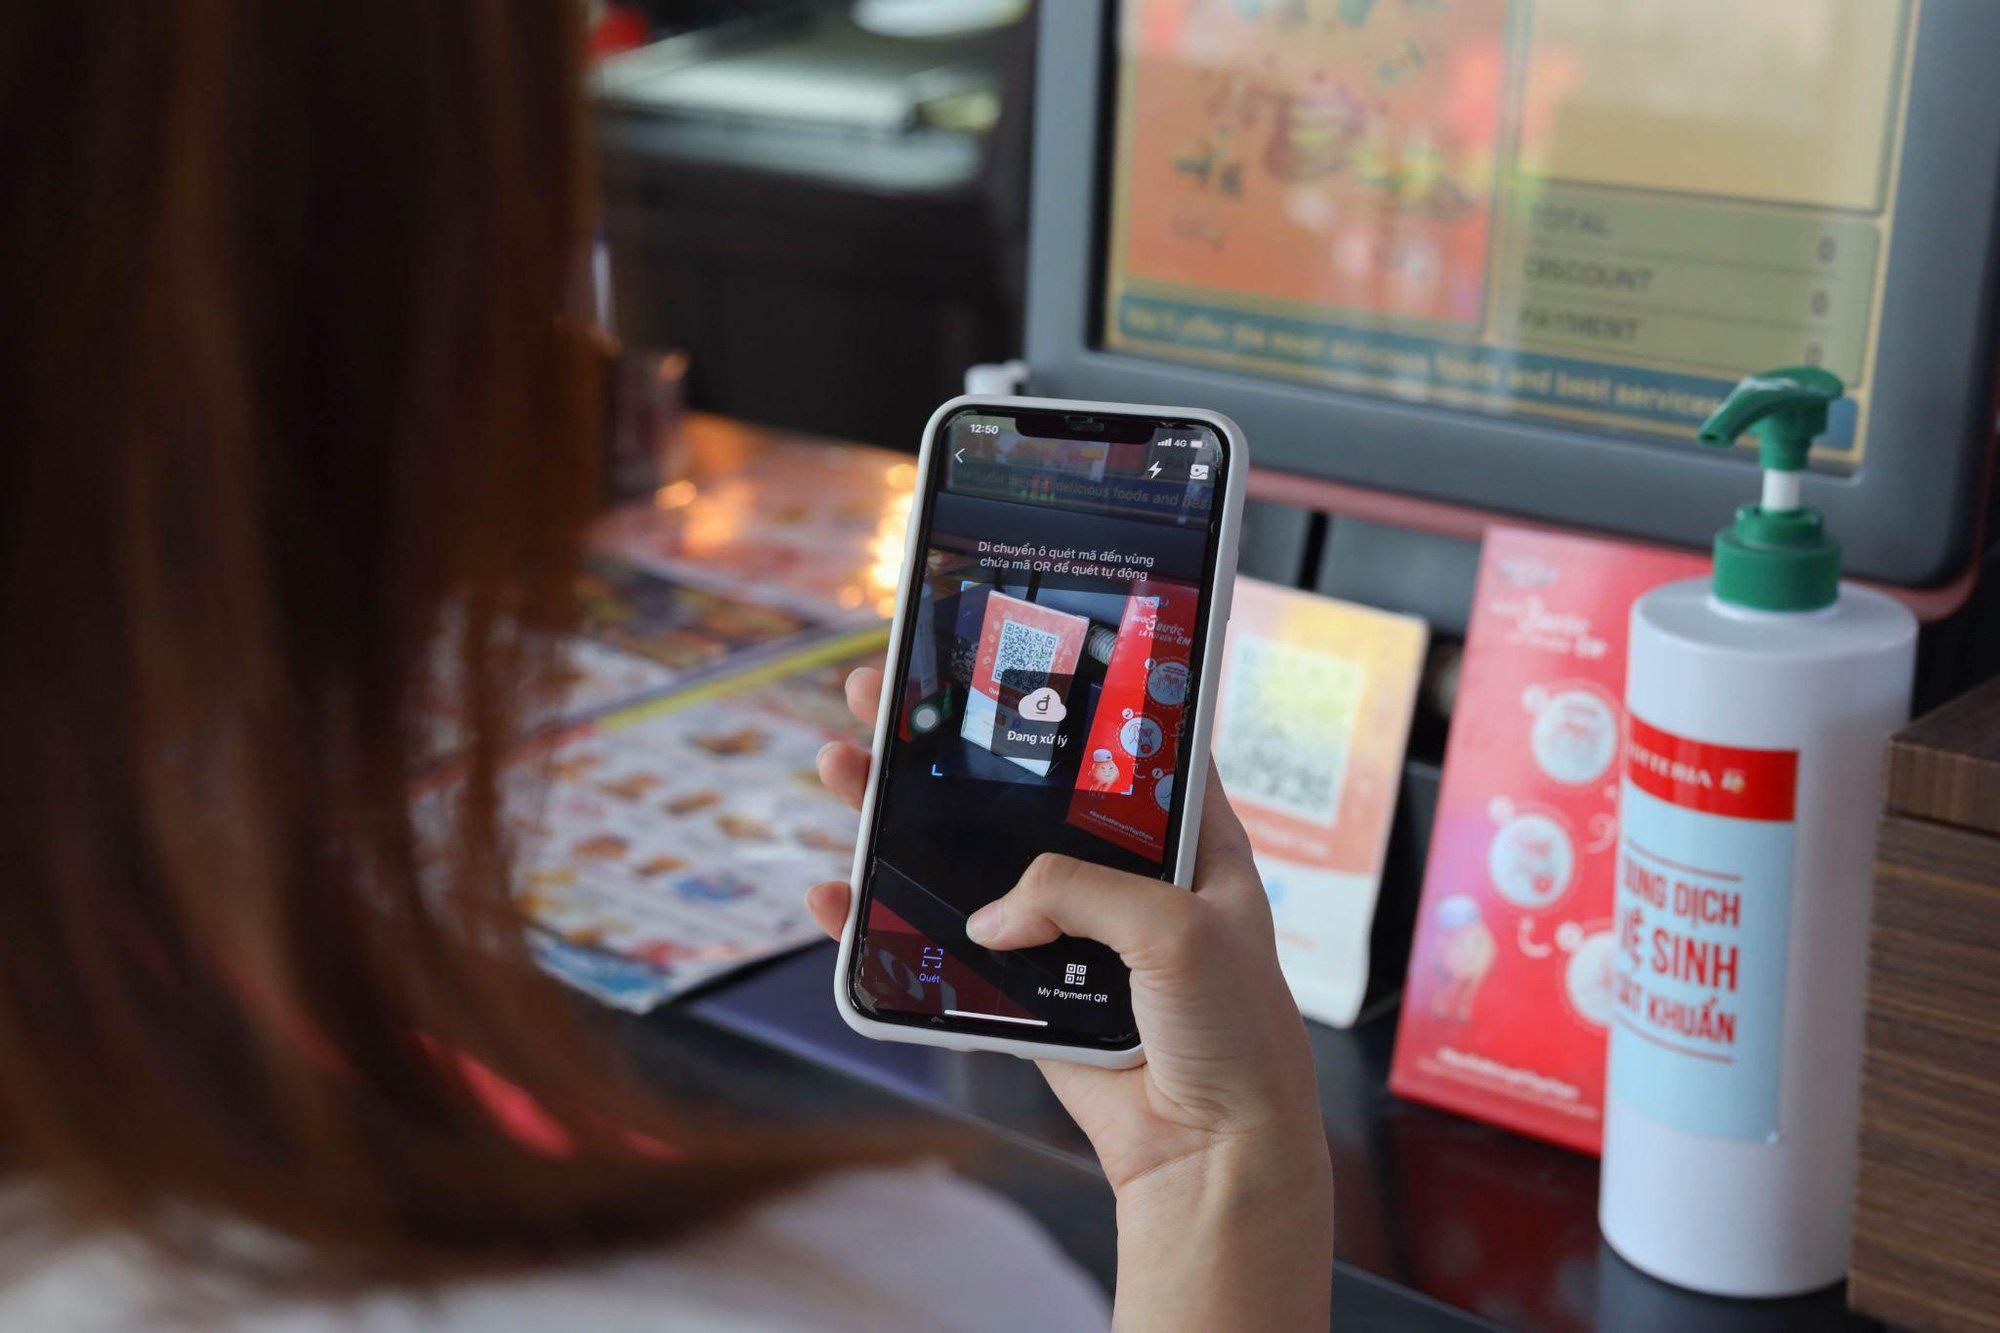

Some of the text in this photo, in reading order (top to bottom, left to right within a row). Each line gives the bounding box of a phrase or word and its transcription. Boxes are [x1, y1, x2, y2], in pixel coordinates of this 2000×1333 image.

[969, 424, 998, 434] 12:50
[1174, 440, 1188, 448] 4G
[1114, 486, 1149, 502] foods
[1153, 492, 1179, 507] and
[978, 541, 991, 552] Di
[993, 542, 1035, 557] chuyển
[1038, 546, 1046, 556] ô
[1049, 548, 1076, 559] quét
[1078, 550, 1097, 560] mã
[1100, 550, 1121, 562] đến
[980, 557, 1148, 582] chứa mã QR để quét tự động
[1007, 730, 1068, 748] Đang xử lý
[1673, 880, 1740, 928] DỊCH
[1651, 926, 1739, 992] SINH
[919, 972, 941, 983] Quét
[1038, 987, 1108, 1003] My Payment QR
